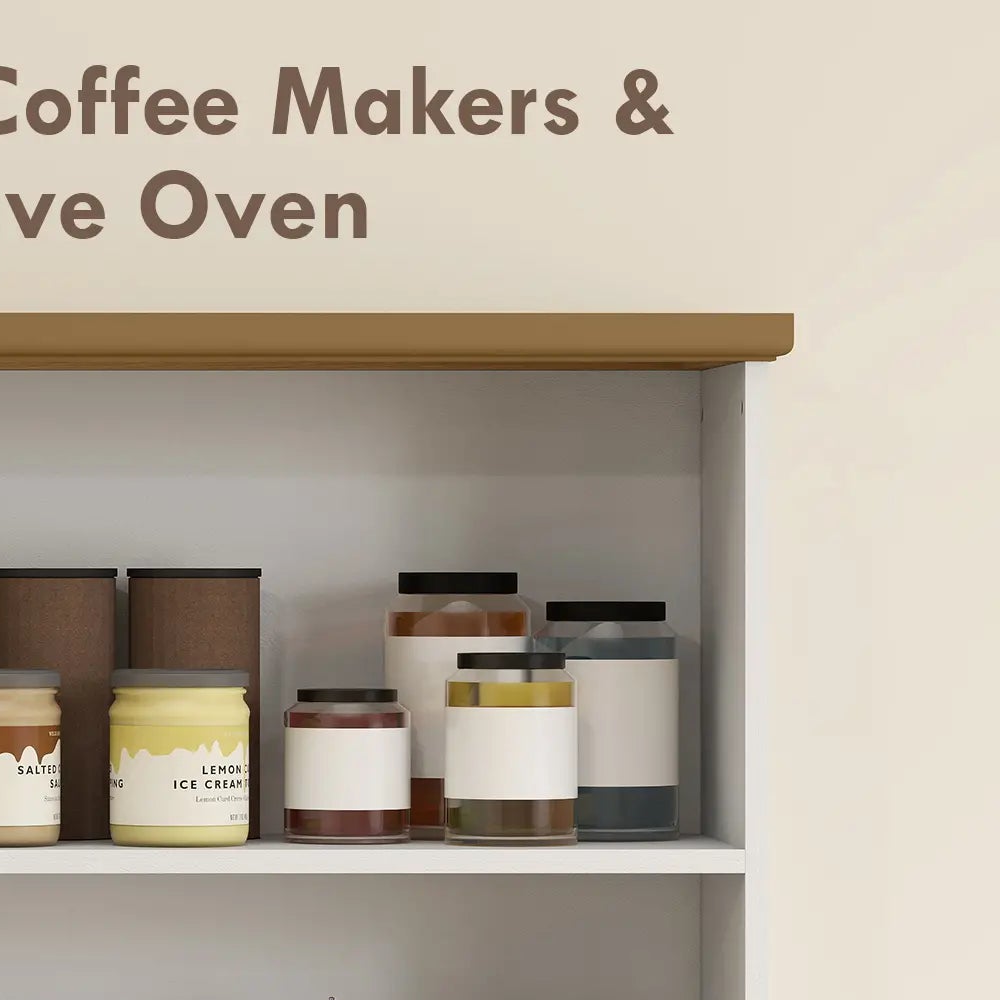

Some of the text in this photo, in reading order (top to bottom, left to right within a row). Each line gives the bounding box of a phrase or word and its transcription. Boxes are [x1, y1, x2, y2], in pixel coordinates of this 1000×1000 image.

[18, 765, 57, 775] SALTED
[202, 765, 242, 775] LEMON
[173, 780, 197, 790] ICE
[205, 779, 242, 789] CREAM
